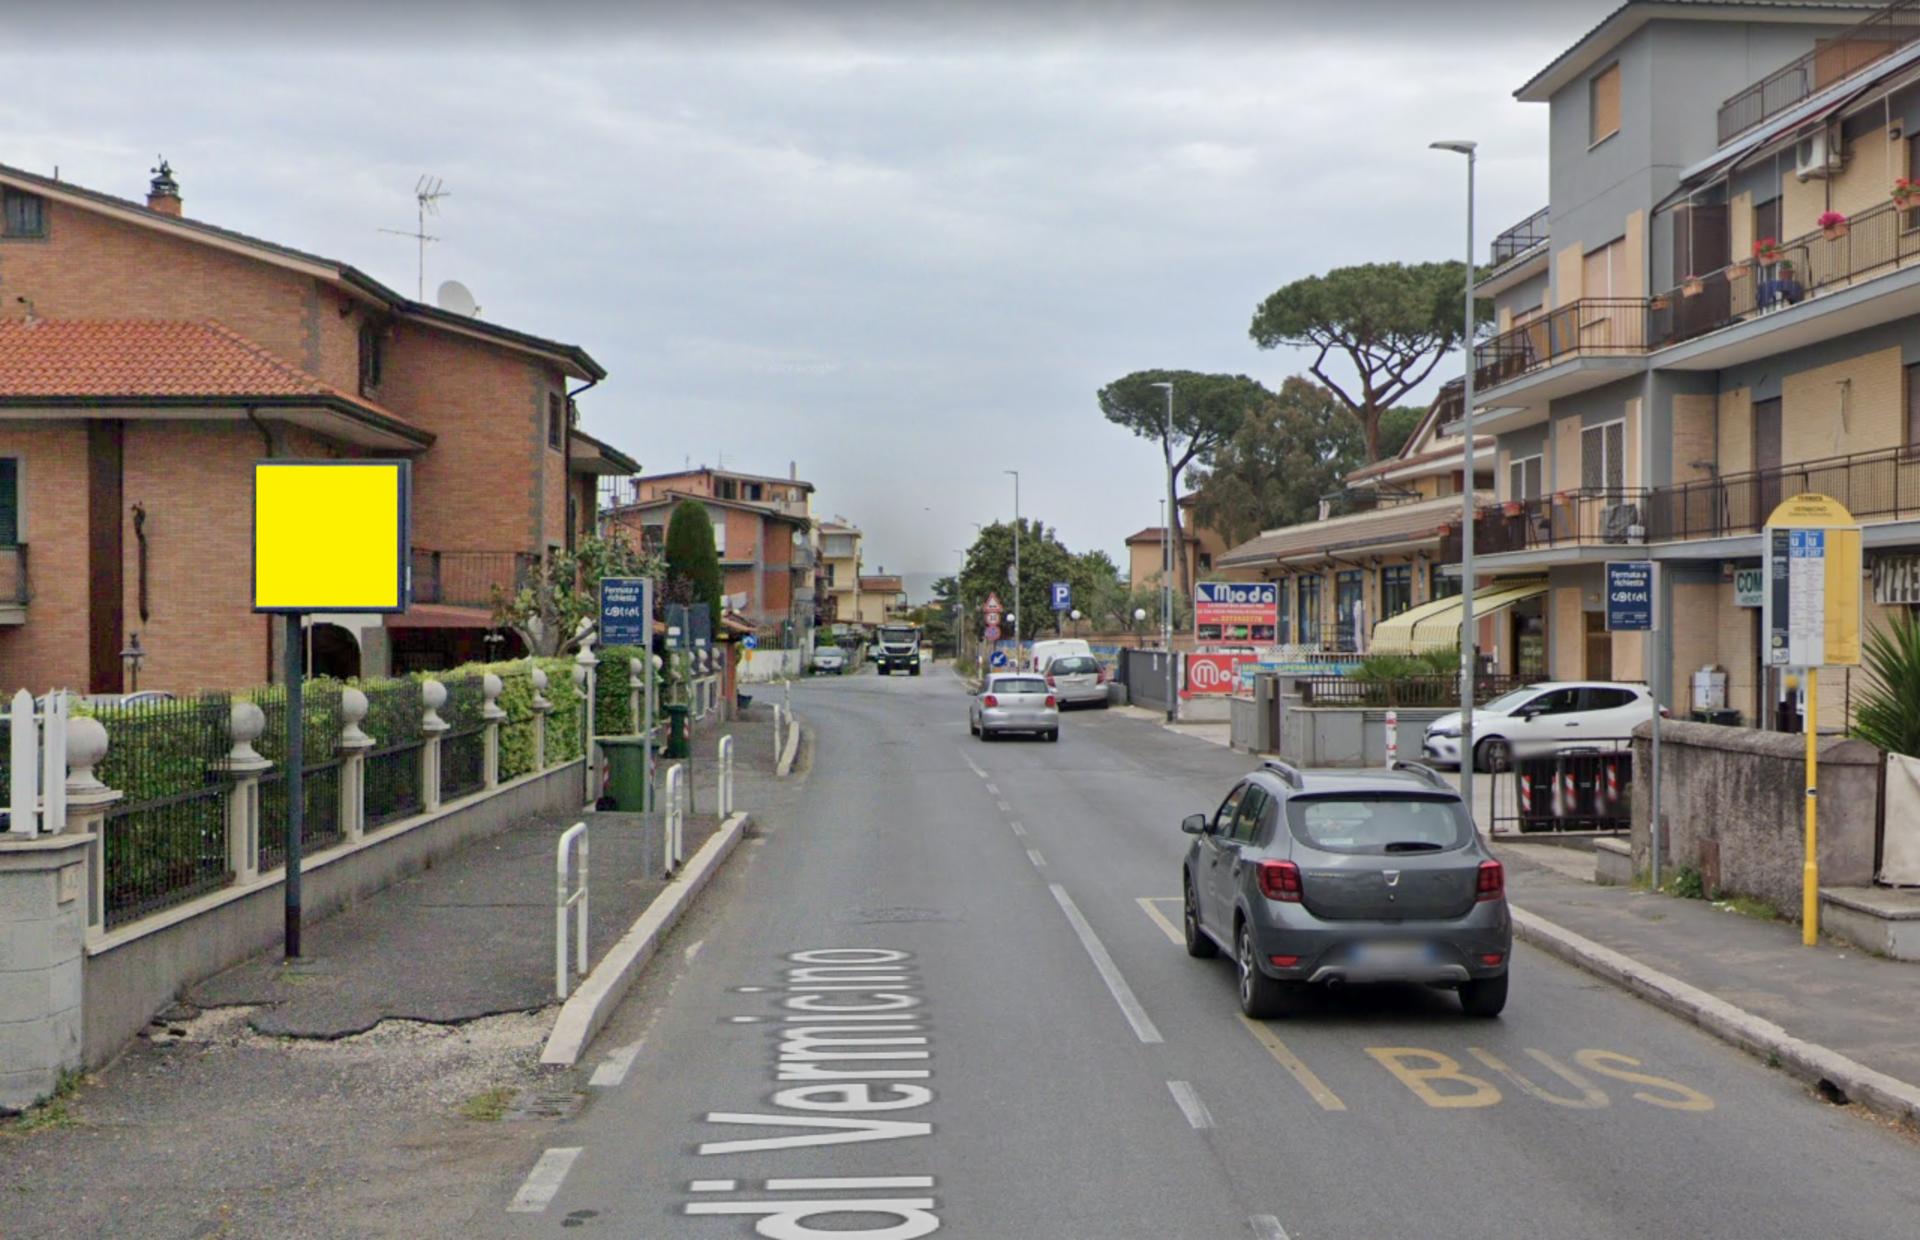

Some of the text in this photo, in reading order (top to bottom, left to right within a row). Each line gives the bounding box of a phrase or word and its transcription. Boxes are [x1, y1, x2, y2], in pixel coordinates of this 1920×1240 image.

[1611, 570, 1641, 579] Fermata
[1613, 578, 1645, 587] richiesta
[605, 585, 634, 594] Fermata
[606, 594, 637, 602] richiesta
[1056, 587, 1068, 603] P
[699, 948, 933, 1156] Vermicino
[1363, 1046, 1715, 1112] BUS
